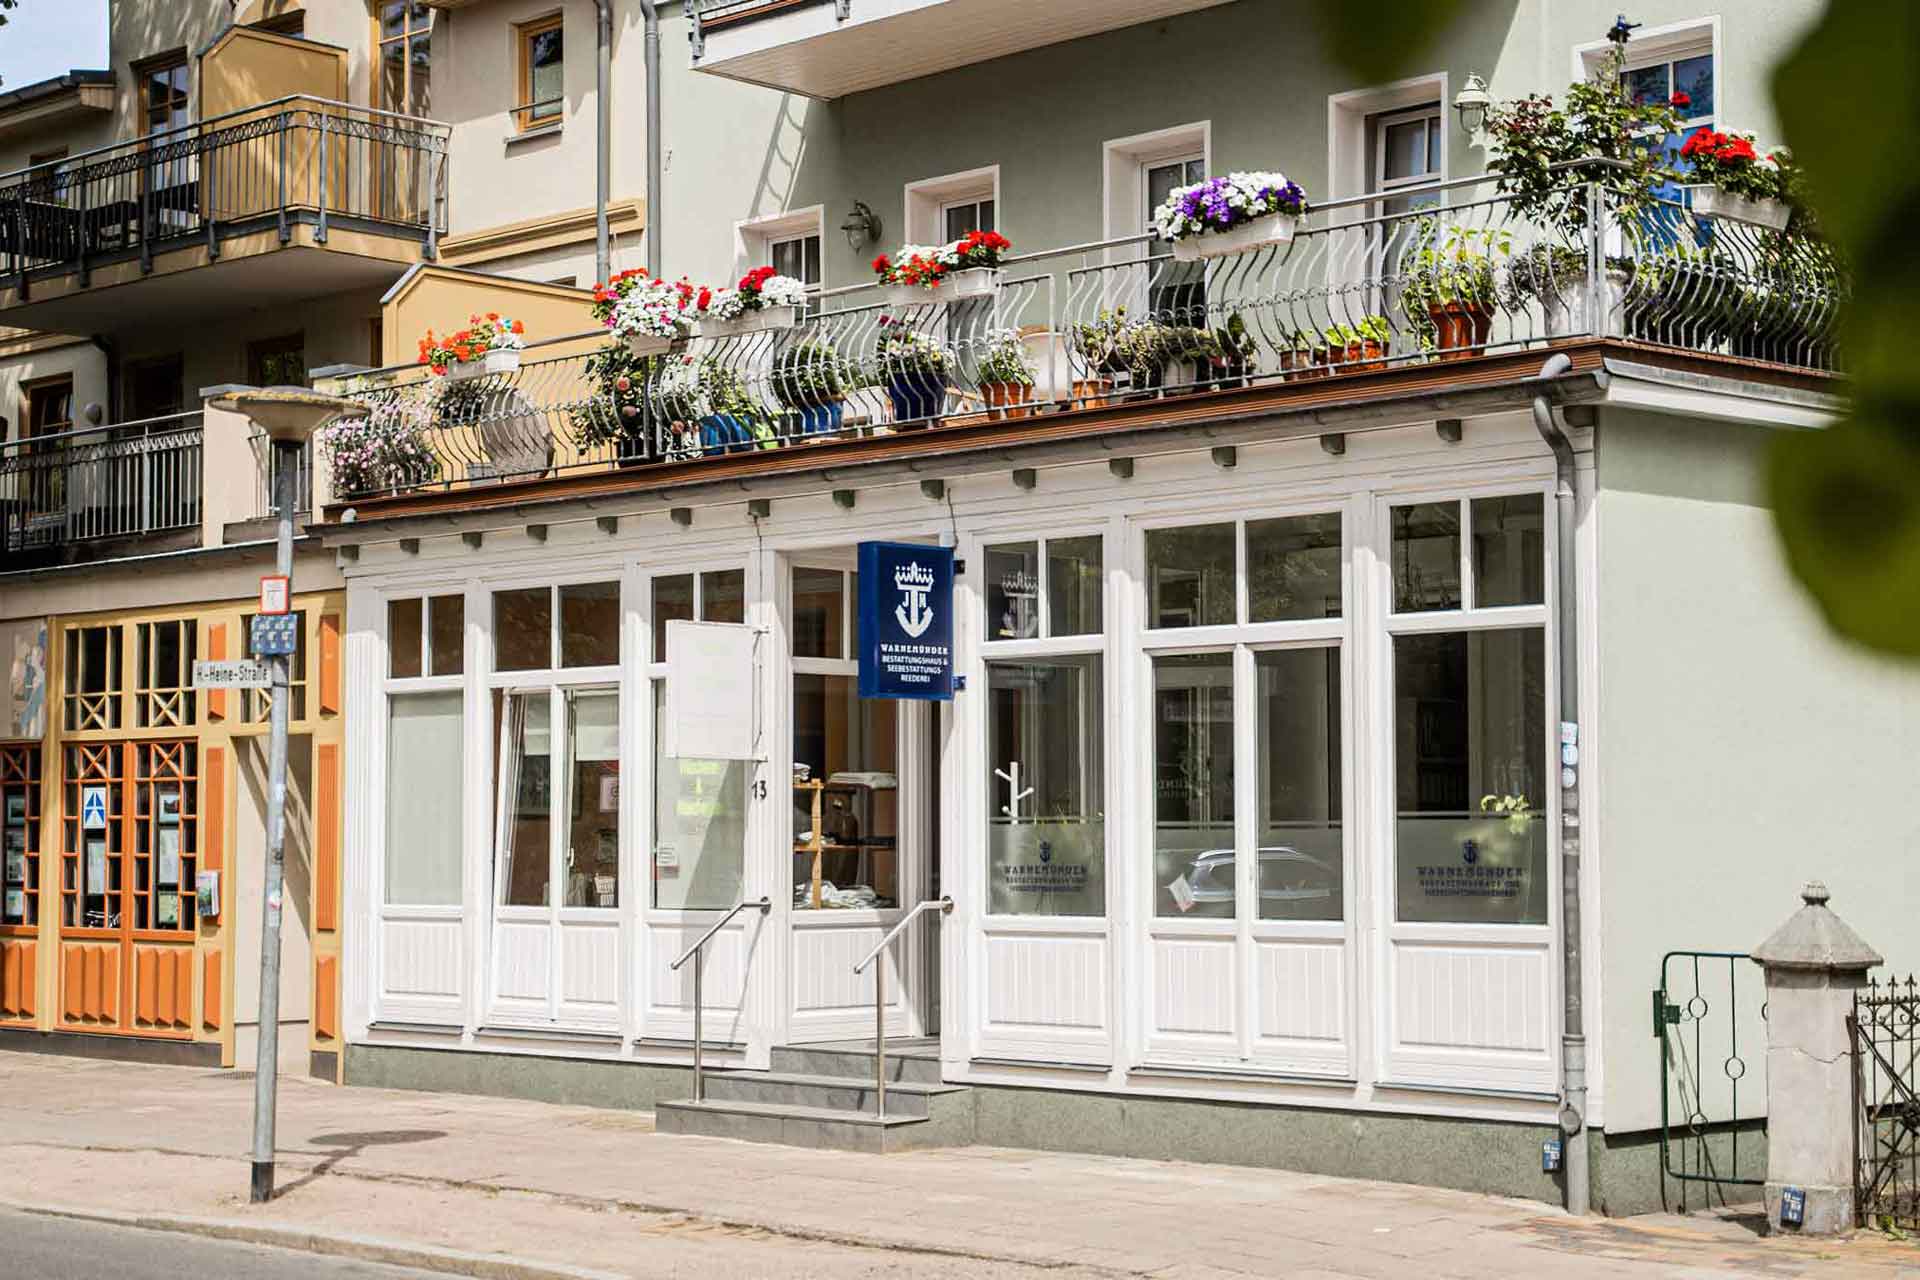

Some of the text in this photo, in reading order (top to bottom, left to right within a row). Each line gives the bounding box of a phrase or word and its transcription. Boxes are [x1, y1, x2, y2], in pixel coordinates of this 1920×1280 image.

[880, 643, 949, 655] WARNEMÜNDER
[882, 655, 942, 665] BESTATTUNGSHAUS
[901, 674, 930, 683] REEDEREI
[752, 780, 767, 800] 13
